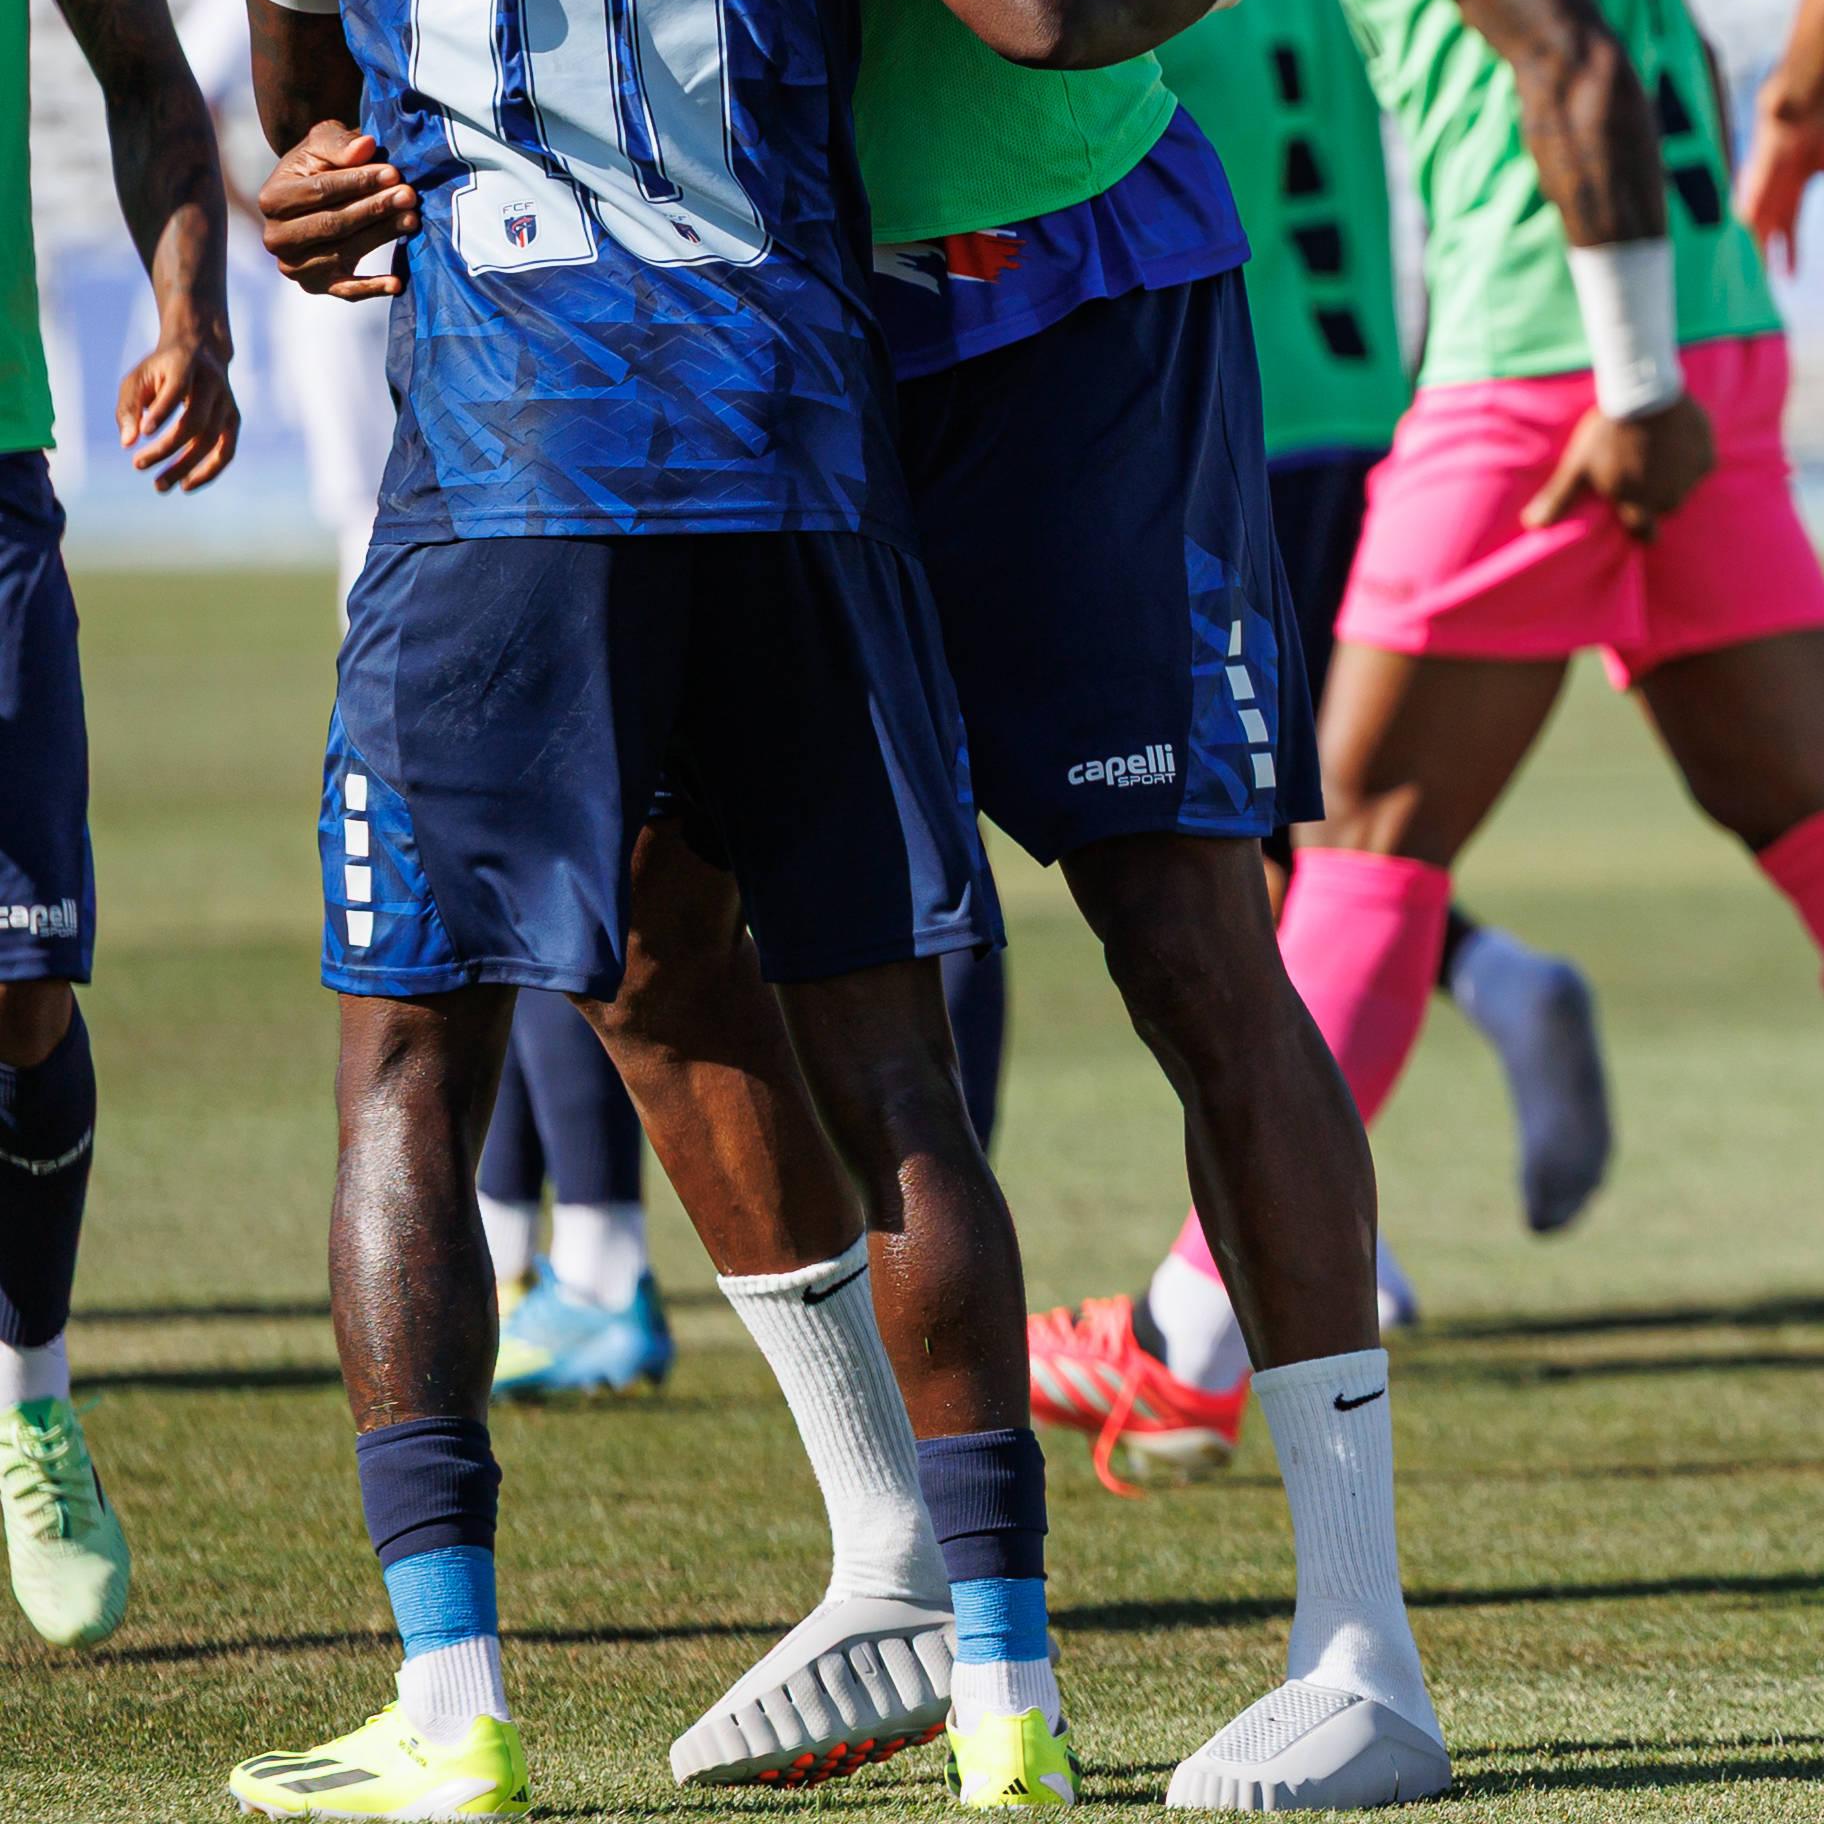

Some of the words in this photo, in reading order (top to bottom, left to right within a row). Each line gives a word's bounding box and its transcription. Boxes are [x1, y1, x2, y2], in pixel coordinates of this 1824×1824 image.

[502, 201, 535, 214] FCF
[1067, 743, 1176, 786] capelli
[1117, 772, 1177, 788] SPORT
